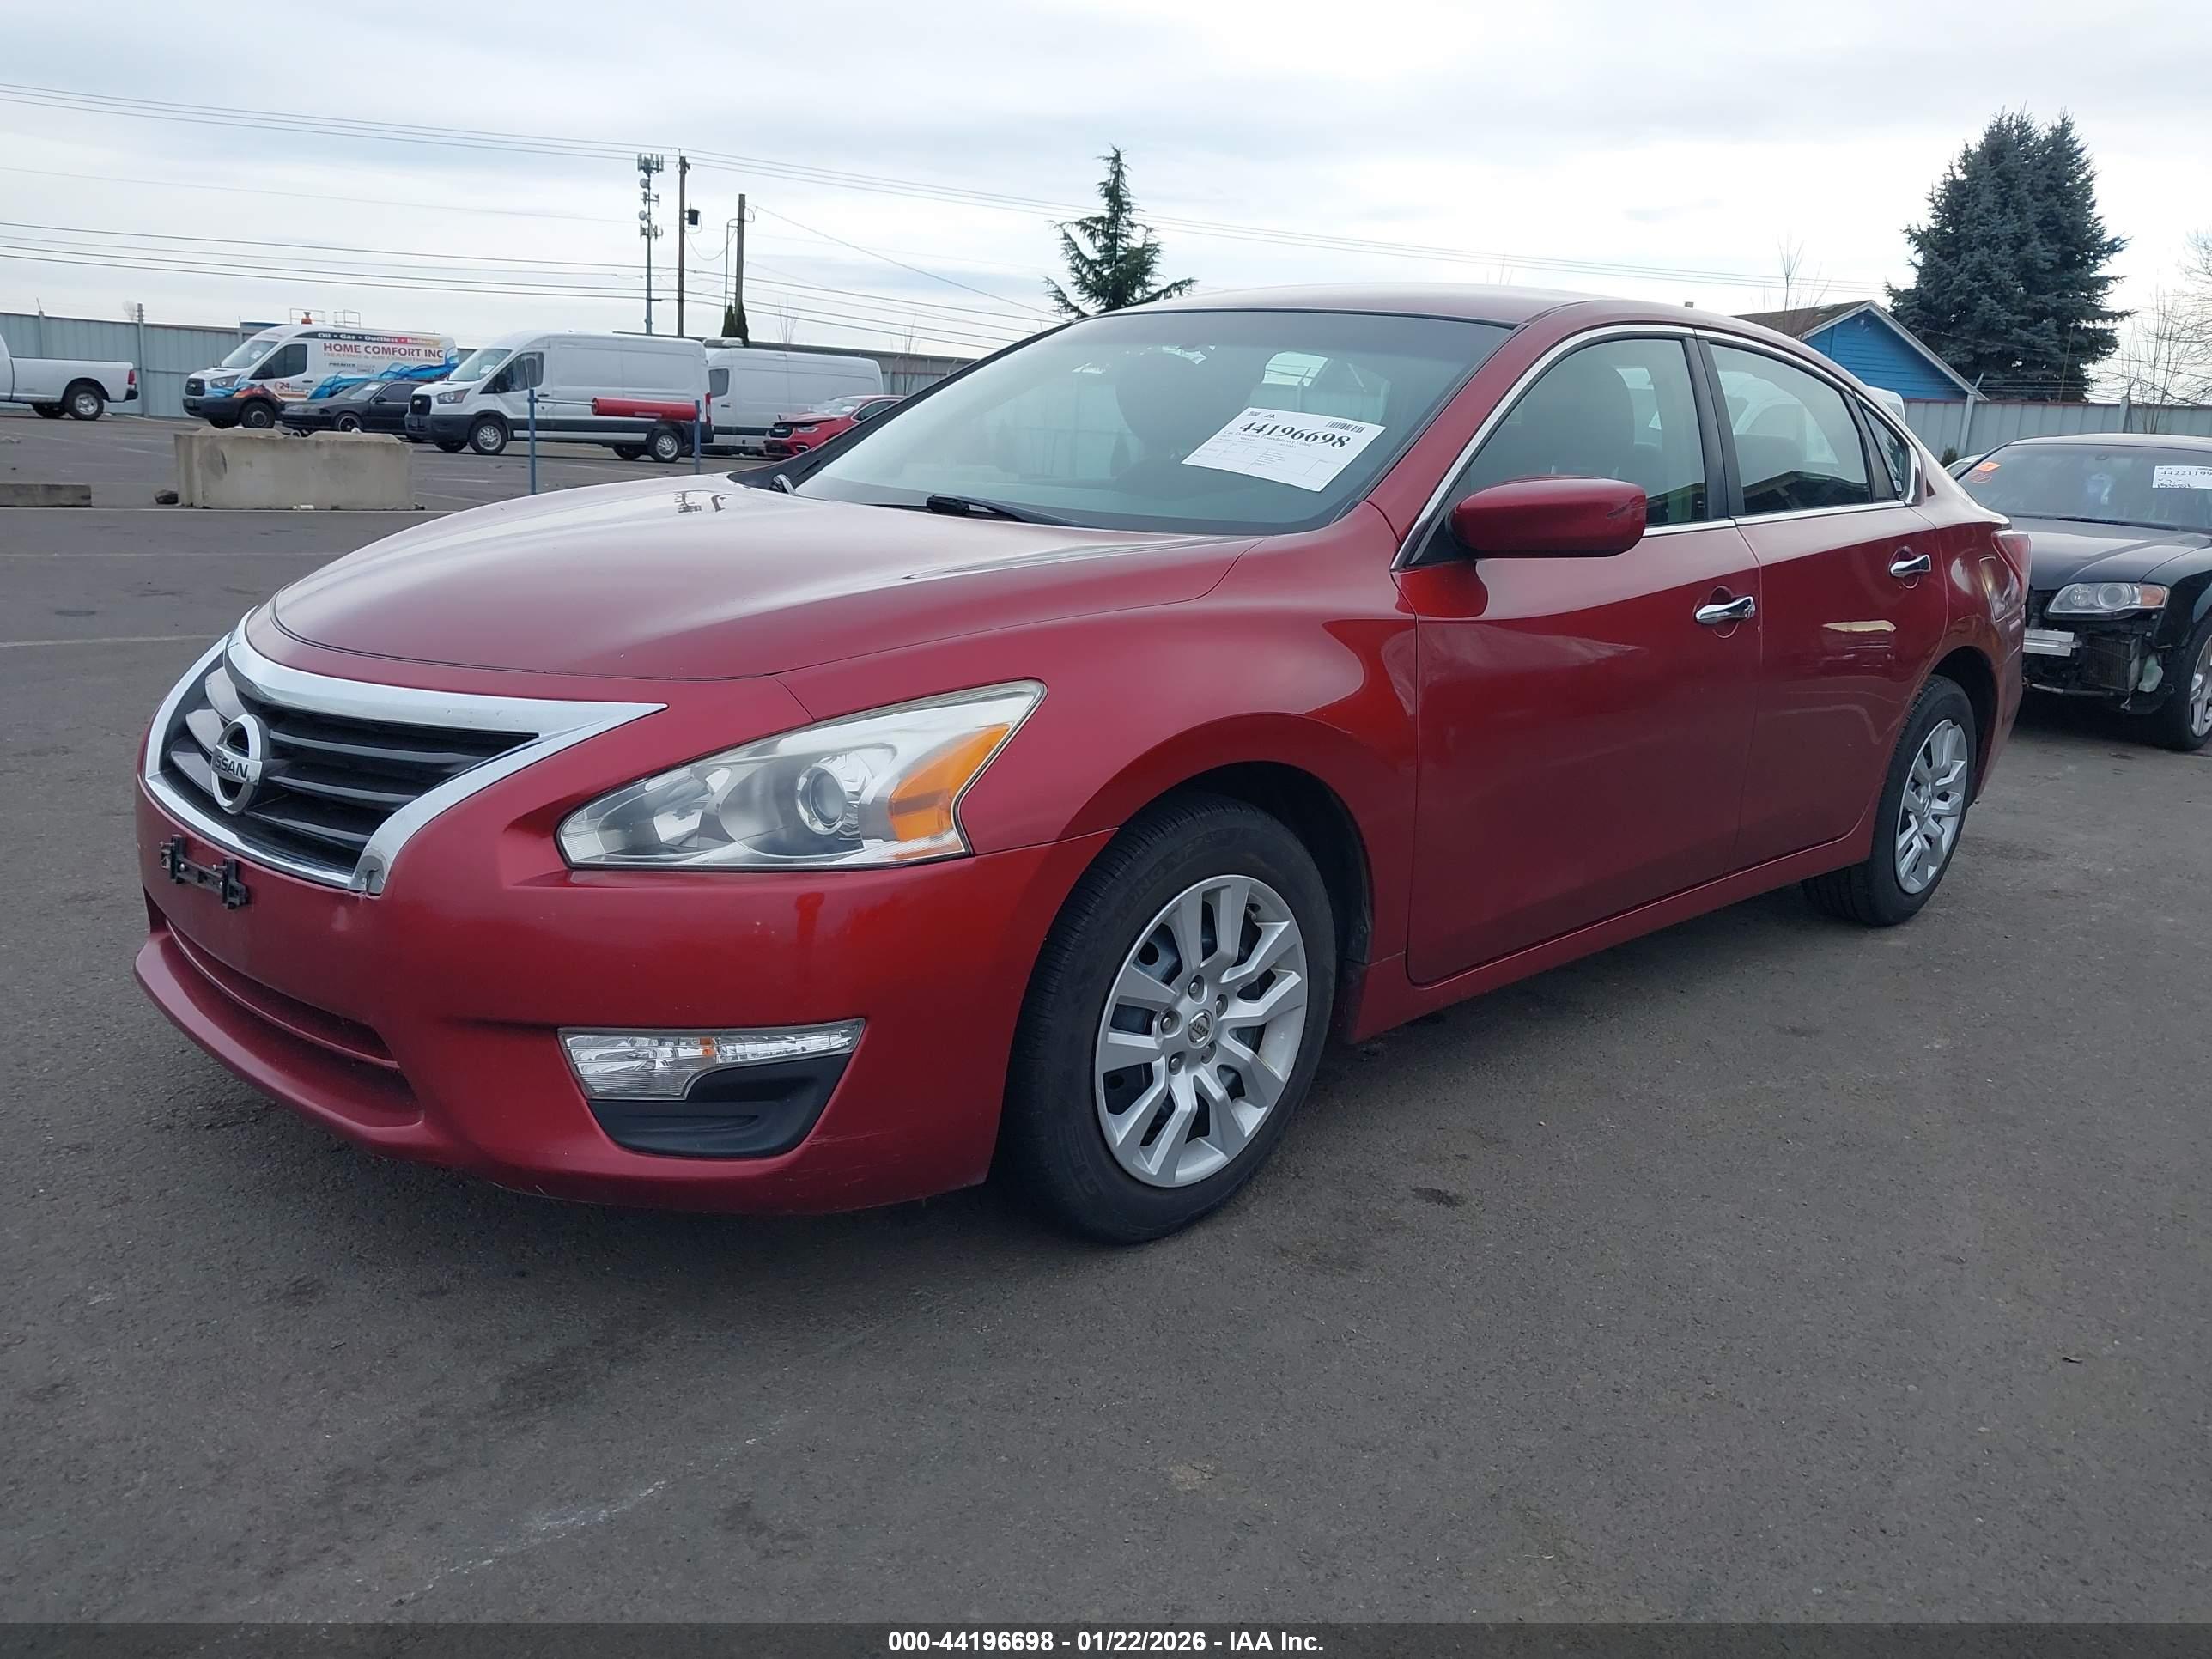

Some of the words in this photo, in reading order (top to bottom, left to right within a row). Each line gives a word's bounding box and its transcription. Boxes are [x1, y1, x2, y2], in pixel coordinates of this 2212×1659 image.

[323, 343, 362, 354] HOME
[364, 345, 422, 357] COMFORT
[424, 349, 444, 359] INC
[1239, 422, 1351, 448] 44196698
